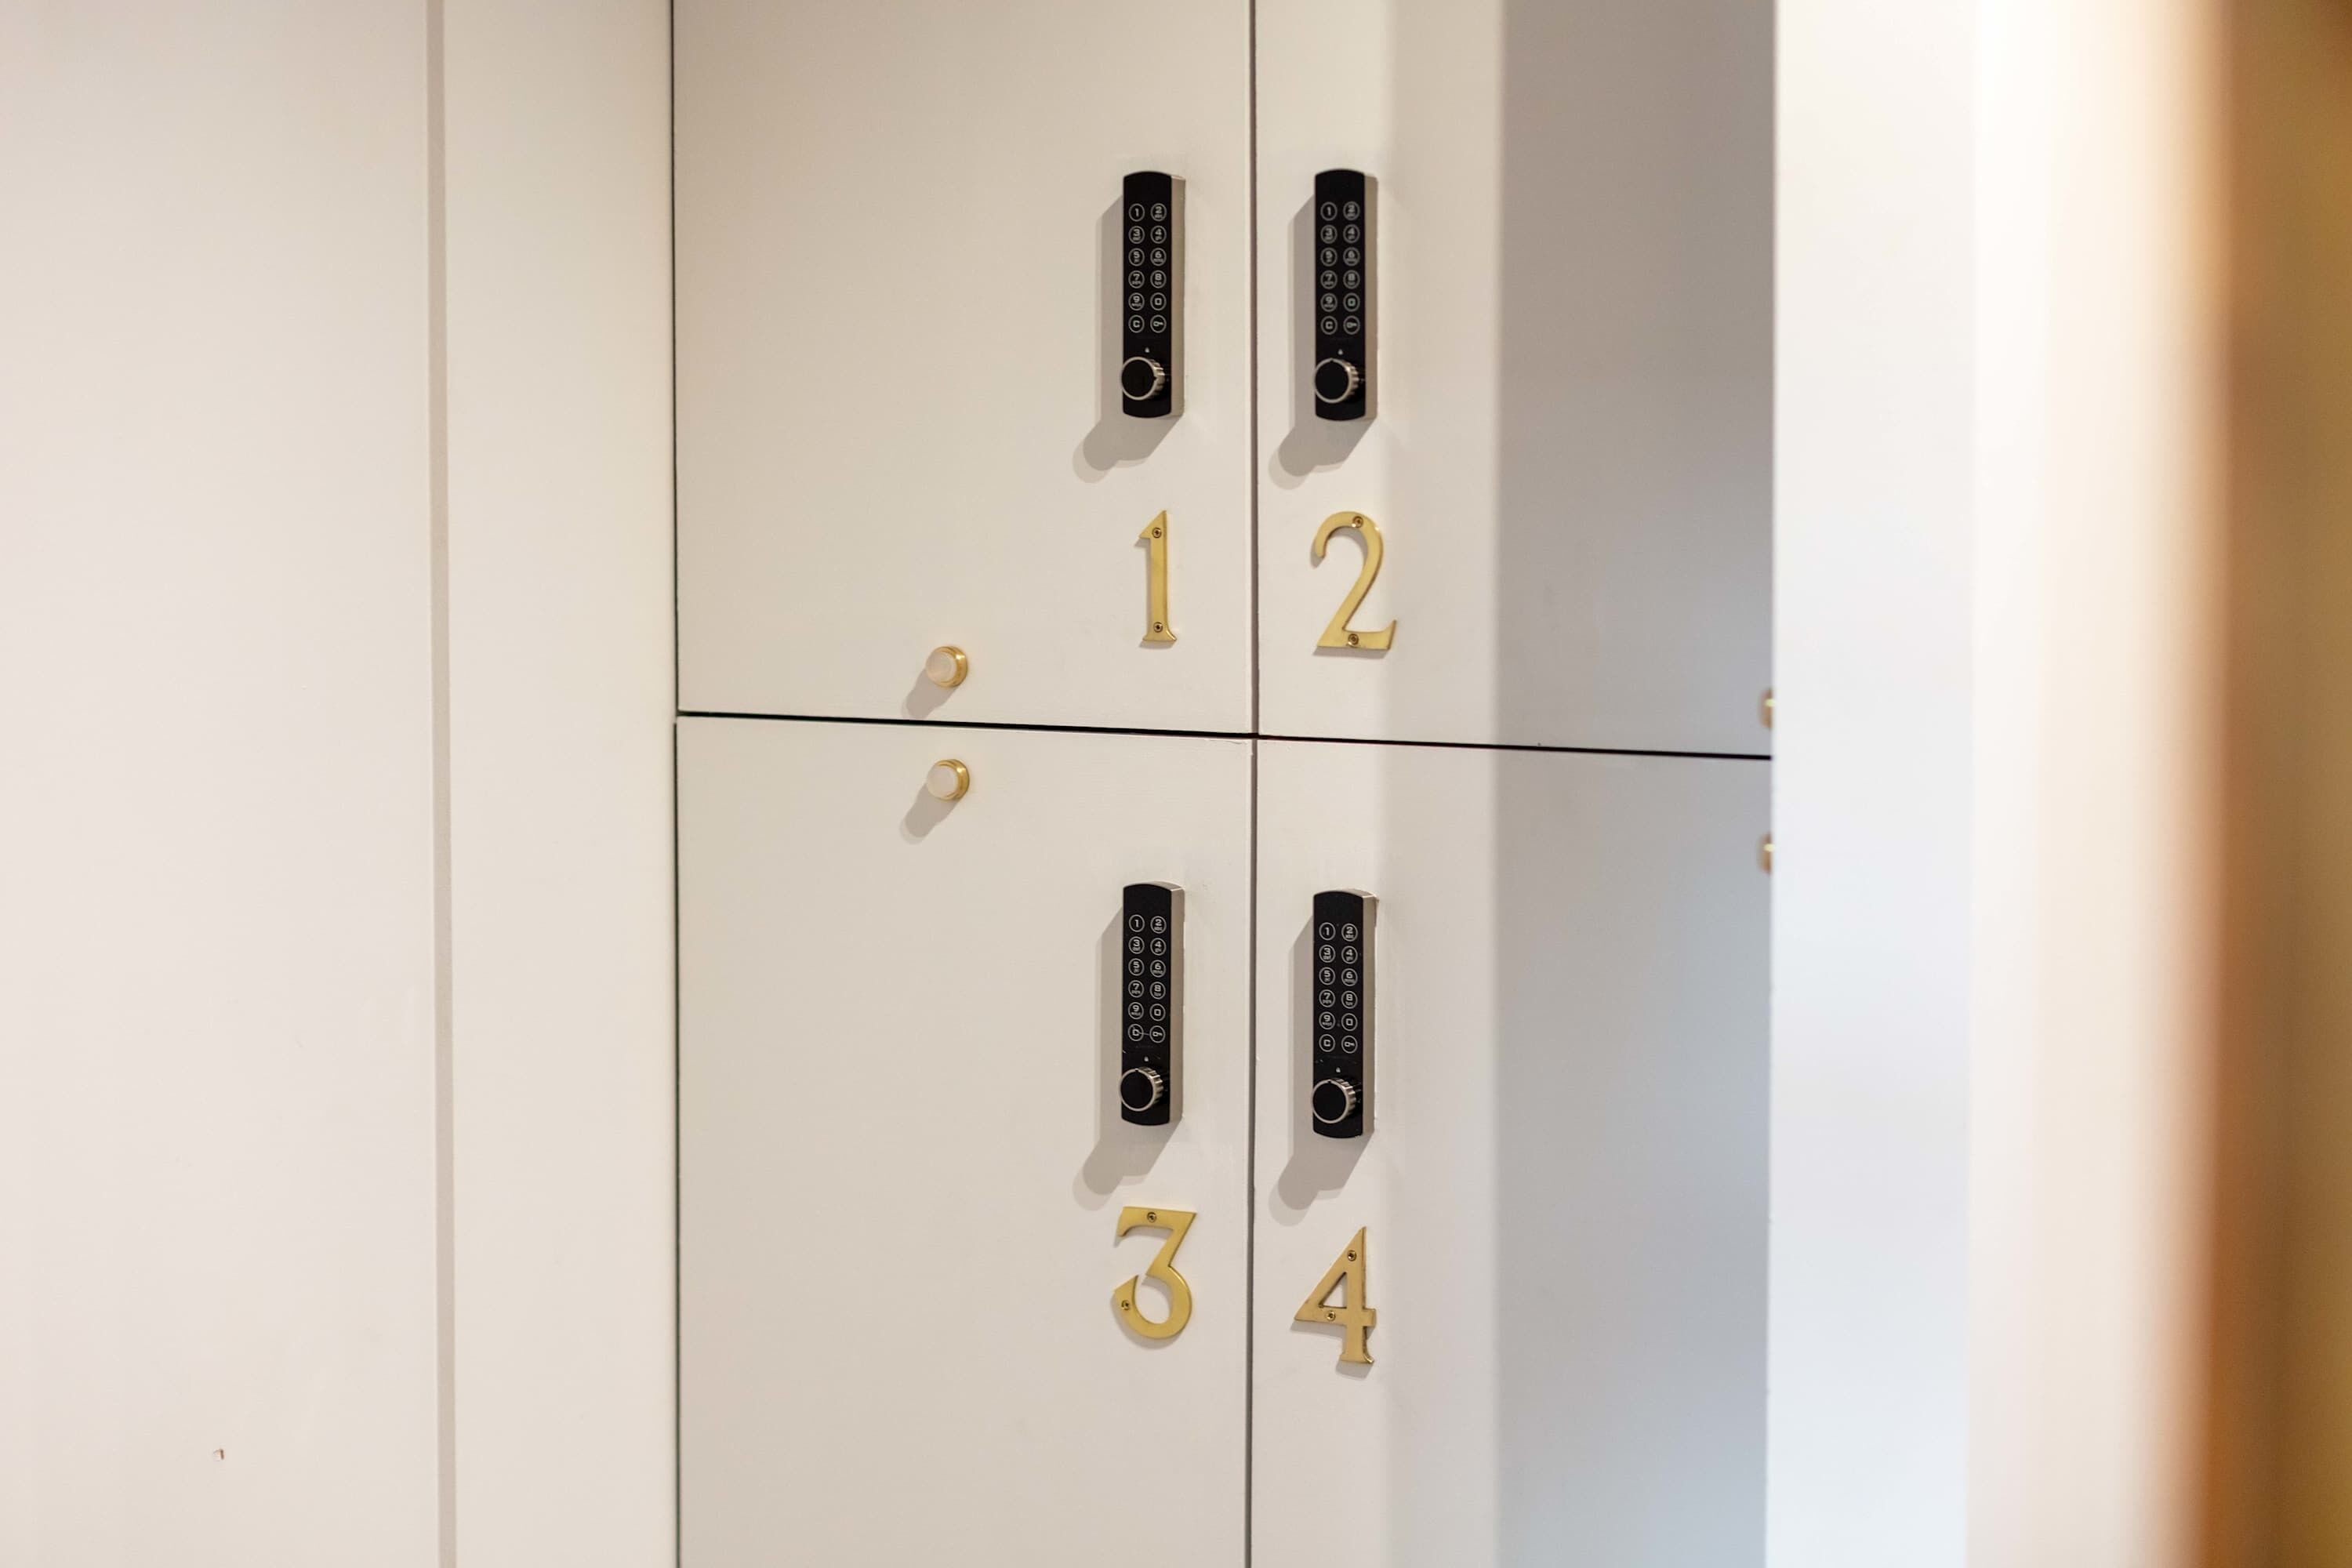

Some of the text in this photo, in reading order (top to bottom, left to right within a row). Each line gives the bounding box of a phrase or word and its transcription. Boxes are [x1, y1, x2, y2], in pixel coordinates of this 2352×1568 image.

[1135, 208, 1139, 217] 1
[1139, 510, 1177, 641] 1
[1314, 510, 1396, 650] 2
[1325, 927, 1329, 935] 1
[1113, 1206, 1197, 1339] 3
[1294, 1225, 1376, 1364] 4
